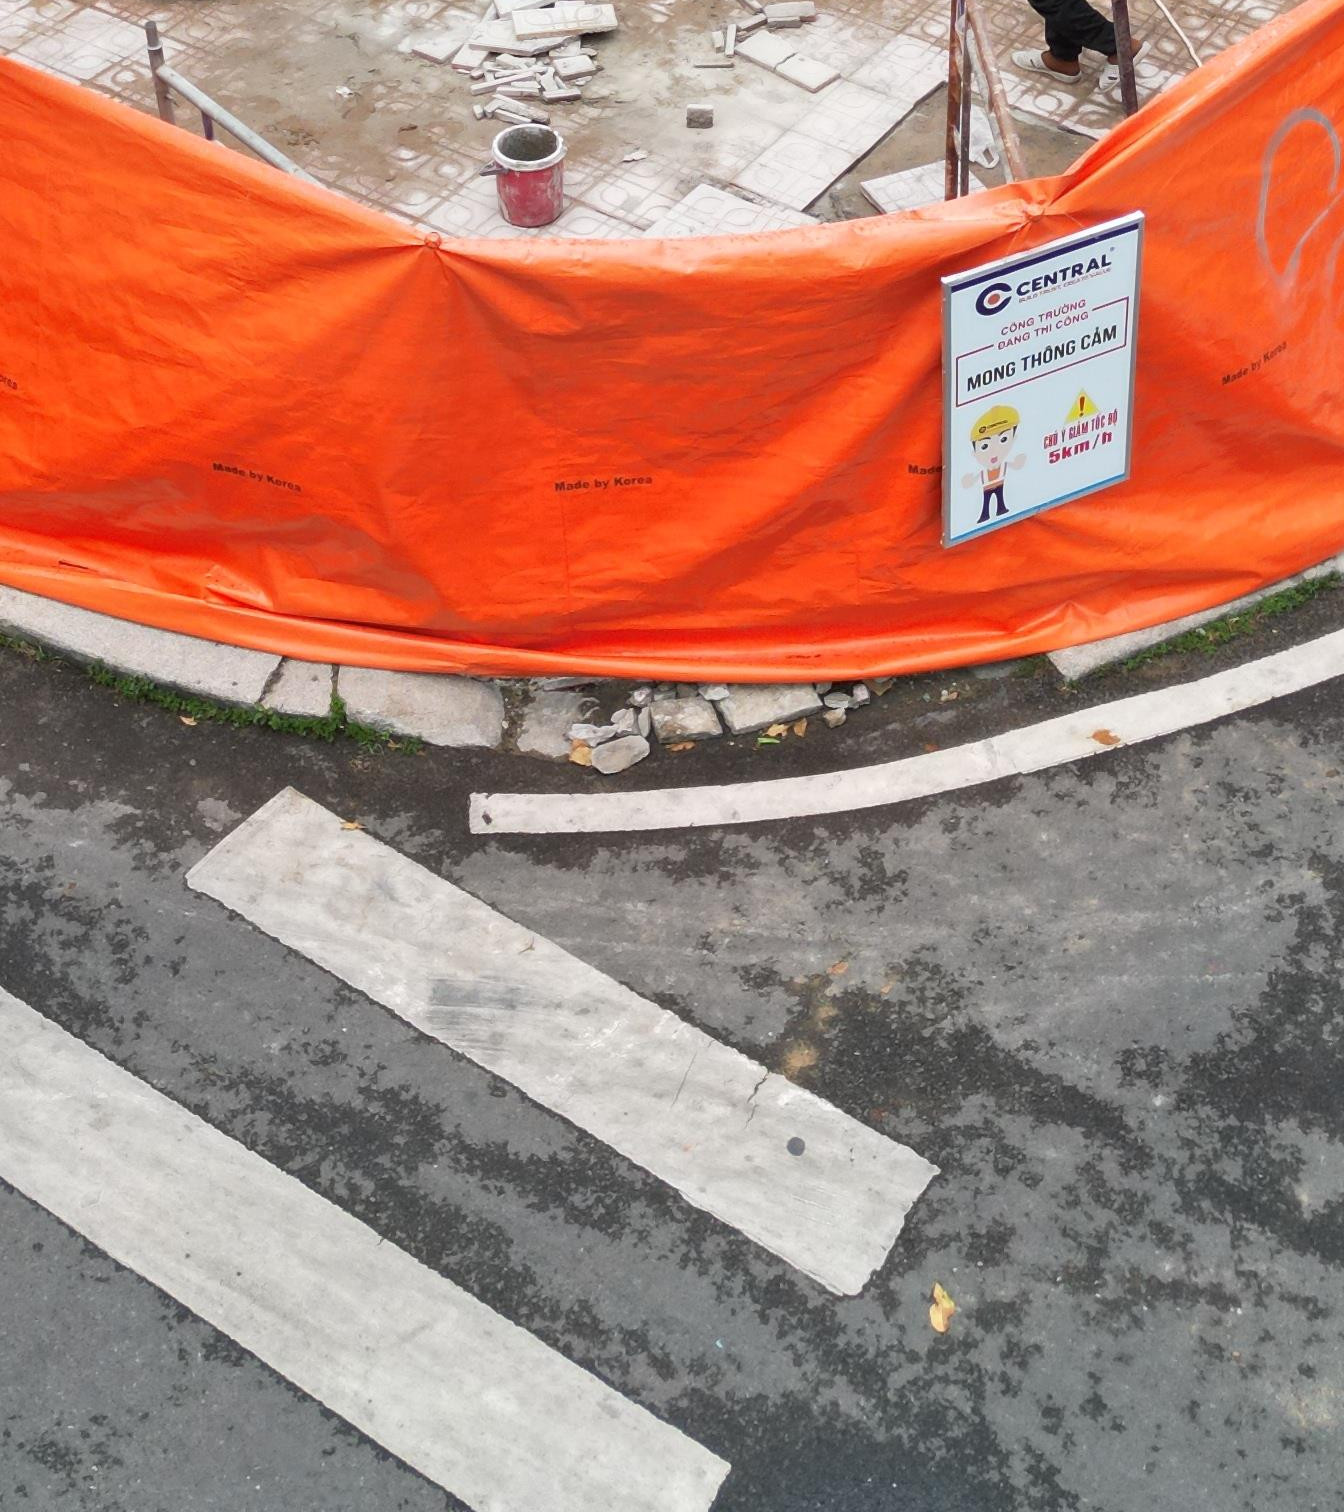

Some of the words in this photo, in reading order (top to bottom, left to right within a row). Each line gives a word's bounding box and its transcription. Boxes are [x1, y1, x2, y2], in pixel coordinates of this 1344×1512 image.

[1016, 254, 1112, 297] CENTRAL
[997, 332, 1031, 350] ĐANG
[1034, 323, 1053, 337] THI
[1055, 311, 1089, 330] CÔNG
[1001, 317, 1035, 336] CÔNG
[1038, 299, 1087, 323] TRƯỜNG
[966, 360, 1016, 392] MONG
[1021, 339, 1076, 373] THÔNG
[1080, 324, 1117, 351] CẢM
[1222, 368, 1249, 386] Made
[1263, 341, 1287, 363] Korea
[212, 462, 246, 477] Made
[248, 470, 264, 482] by
[266, 474, 302, 493] Korea
[554, 481, 590, 492] Made
[594, 478, 609, 490] by
[613, 476, 653, 487] Korea
